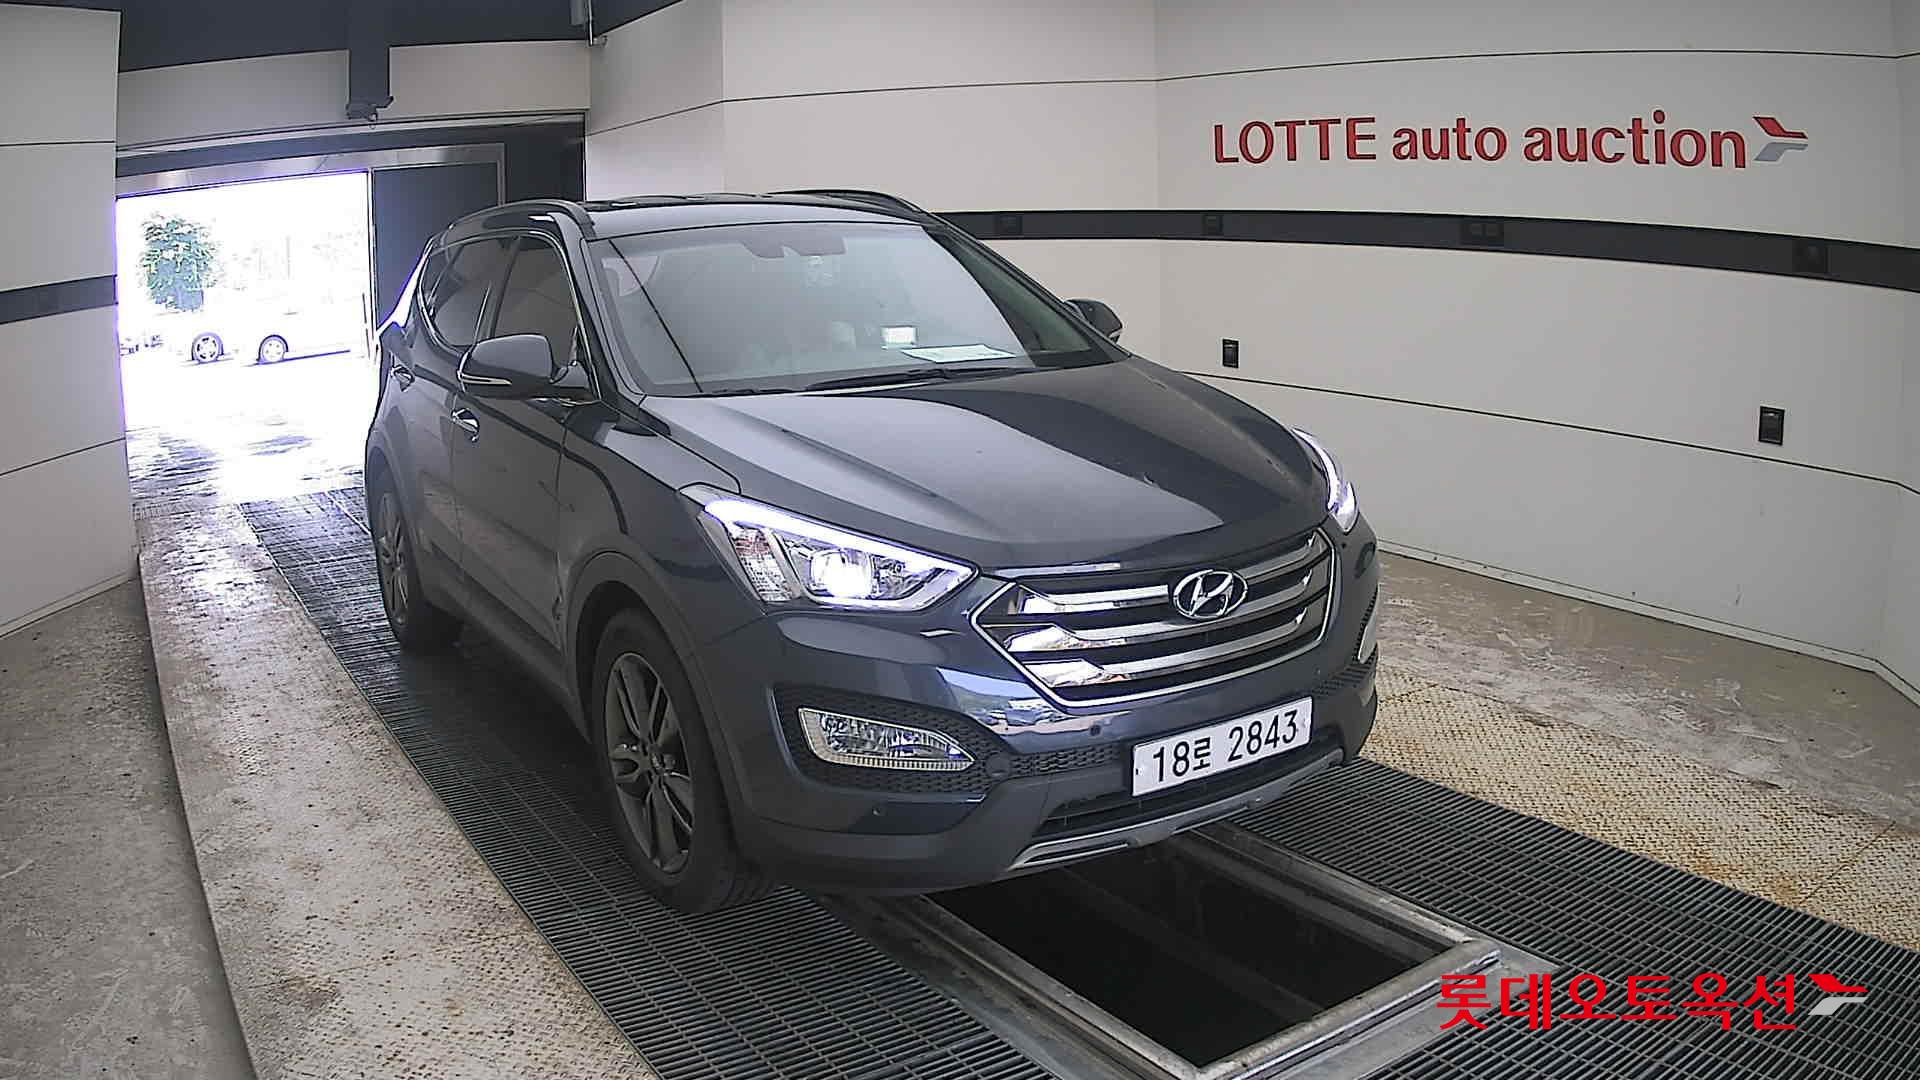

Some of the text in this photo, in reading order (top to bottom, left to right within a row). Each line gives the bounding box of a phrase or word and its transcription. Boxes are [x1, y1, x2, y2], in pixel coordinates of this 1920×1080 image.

[1214, 110, 1747, 169] LOTTE auto auction
[1152, 709, 1298, 783] 18로 2843
